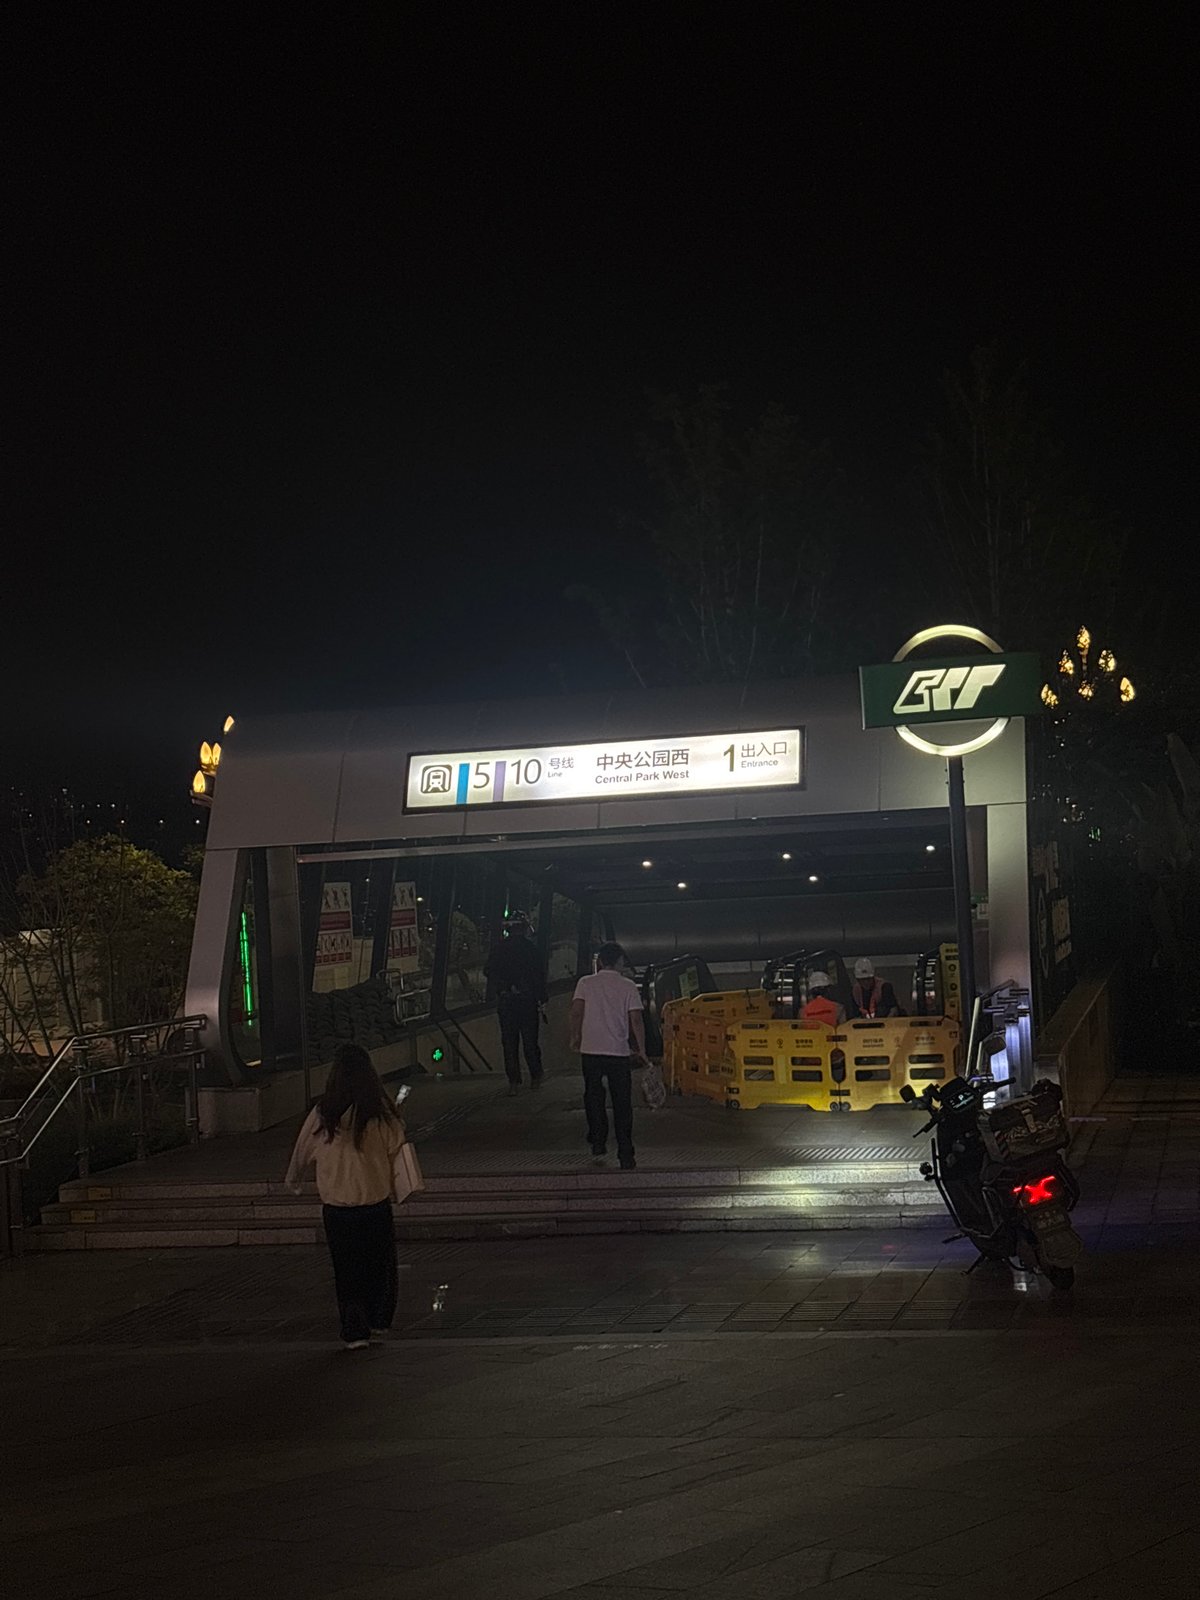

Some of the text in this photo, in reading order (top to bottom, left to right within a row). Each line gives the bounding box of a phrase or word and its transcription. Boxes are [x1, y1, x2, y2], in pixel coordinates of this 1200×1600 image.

[596, 748, 690, 771] 中央公园西
[723, 742, 788, 772] 1 出入口
[741, 759, 779, 768] Entrance
[473, 757, 574, 789] 5 10 号线
[595, 770, 690, 785] Central Park West
